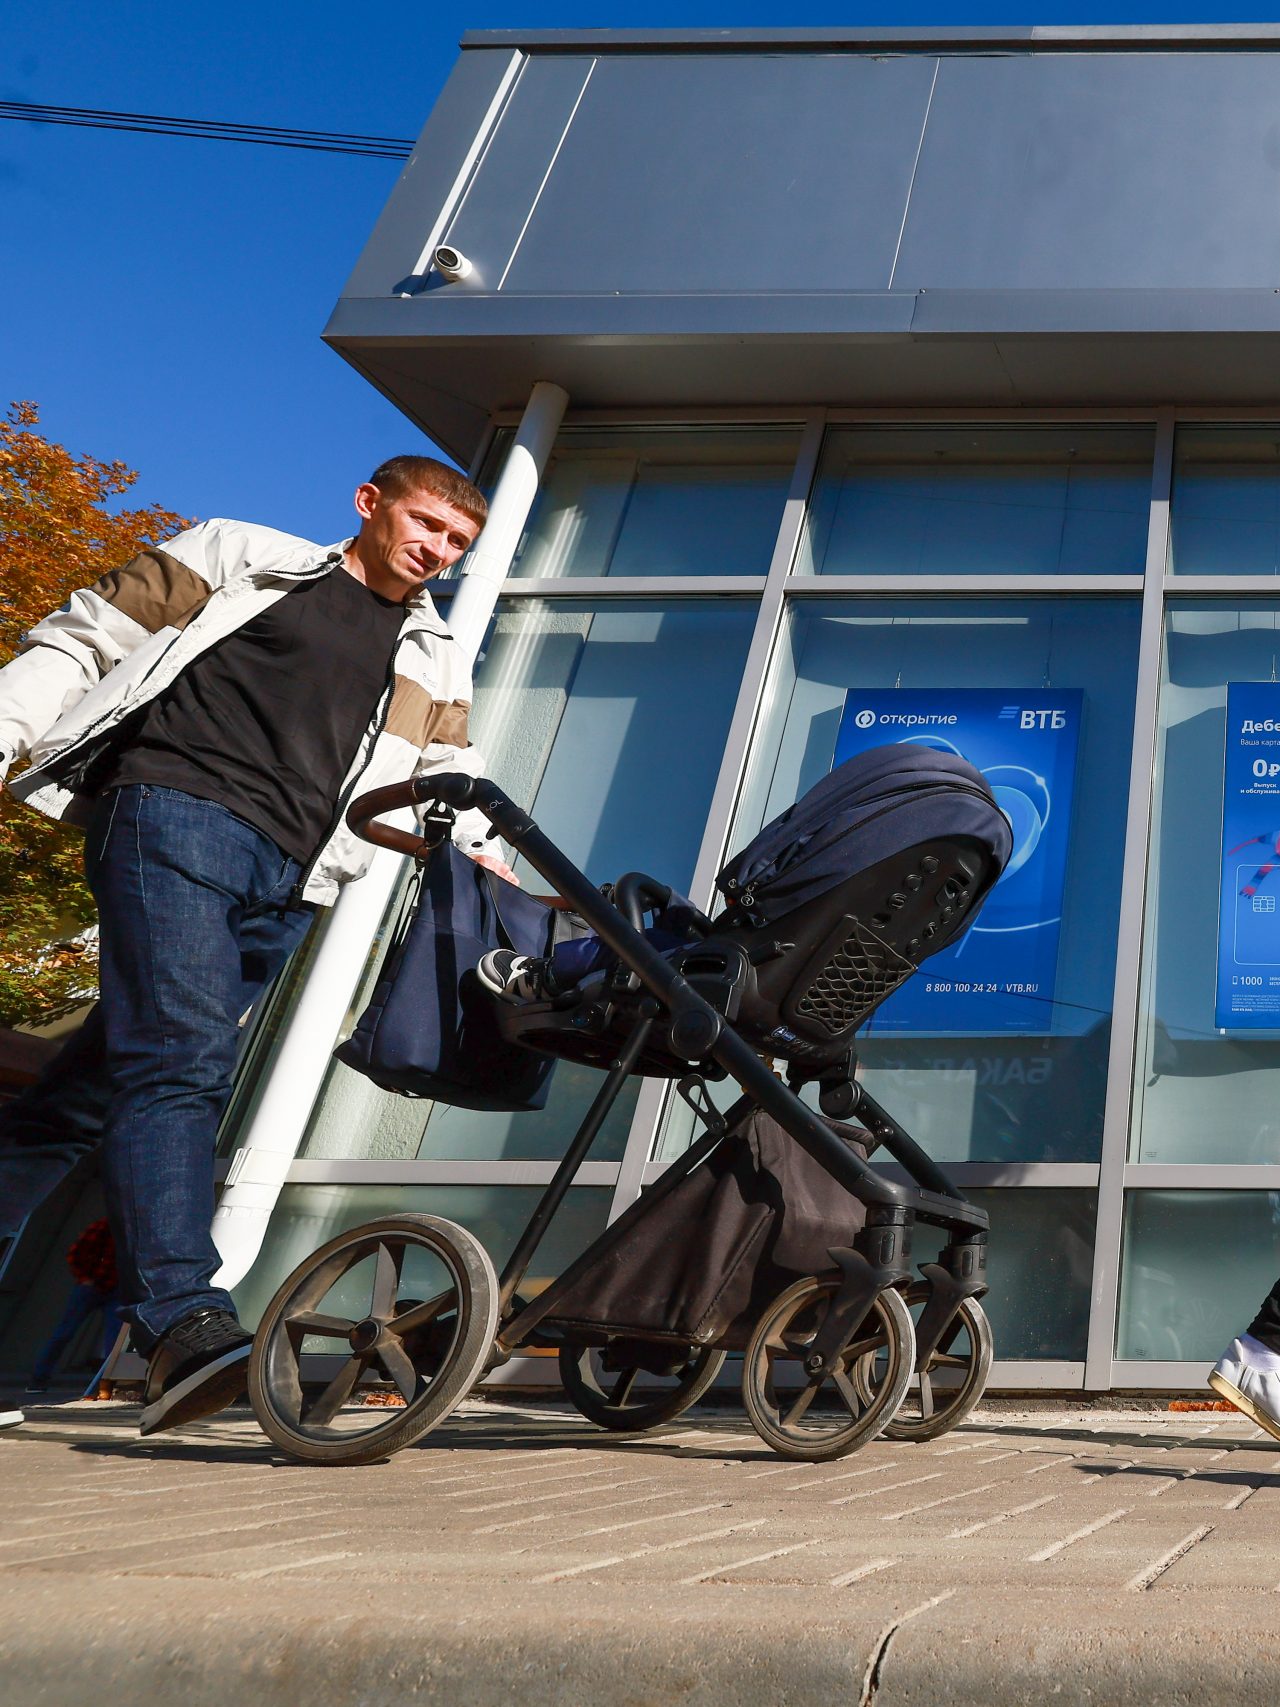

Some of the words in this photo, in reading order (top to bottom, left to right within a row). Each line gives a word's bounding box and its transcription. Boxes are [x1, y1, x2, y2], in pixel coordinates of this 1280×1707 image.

[879, 712, 958, 726] открытие
[1020, 710, 1067, 729] ВТБ
[1240, 976, 1263, 986] 1000
[925, 983, 932, 993] 8
[933, 983, 952, 993] 800
[953, 983, 971, 993] 100
[972, 983, 985, 993] 24
[986, 983, 998, 993] 24
[1005, 983, 1039, 993] VTB.RU
